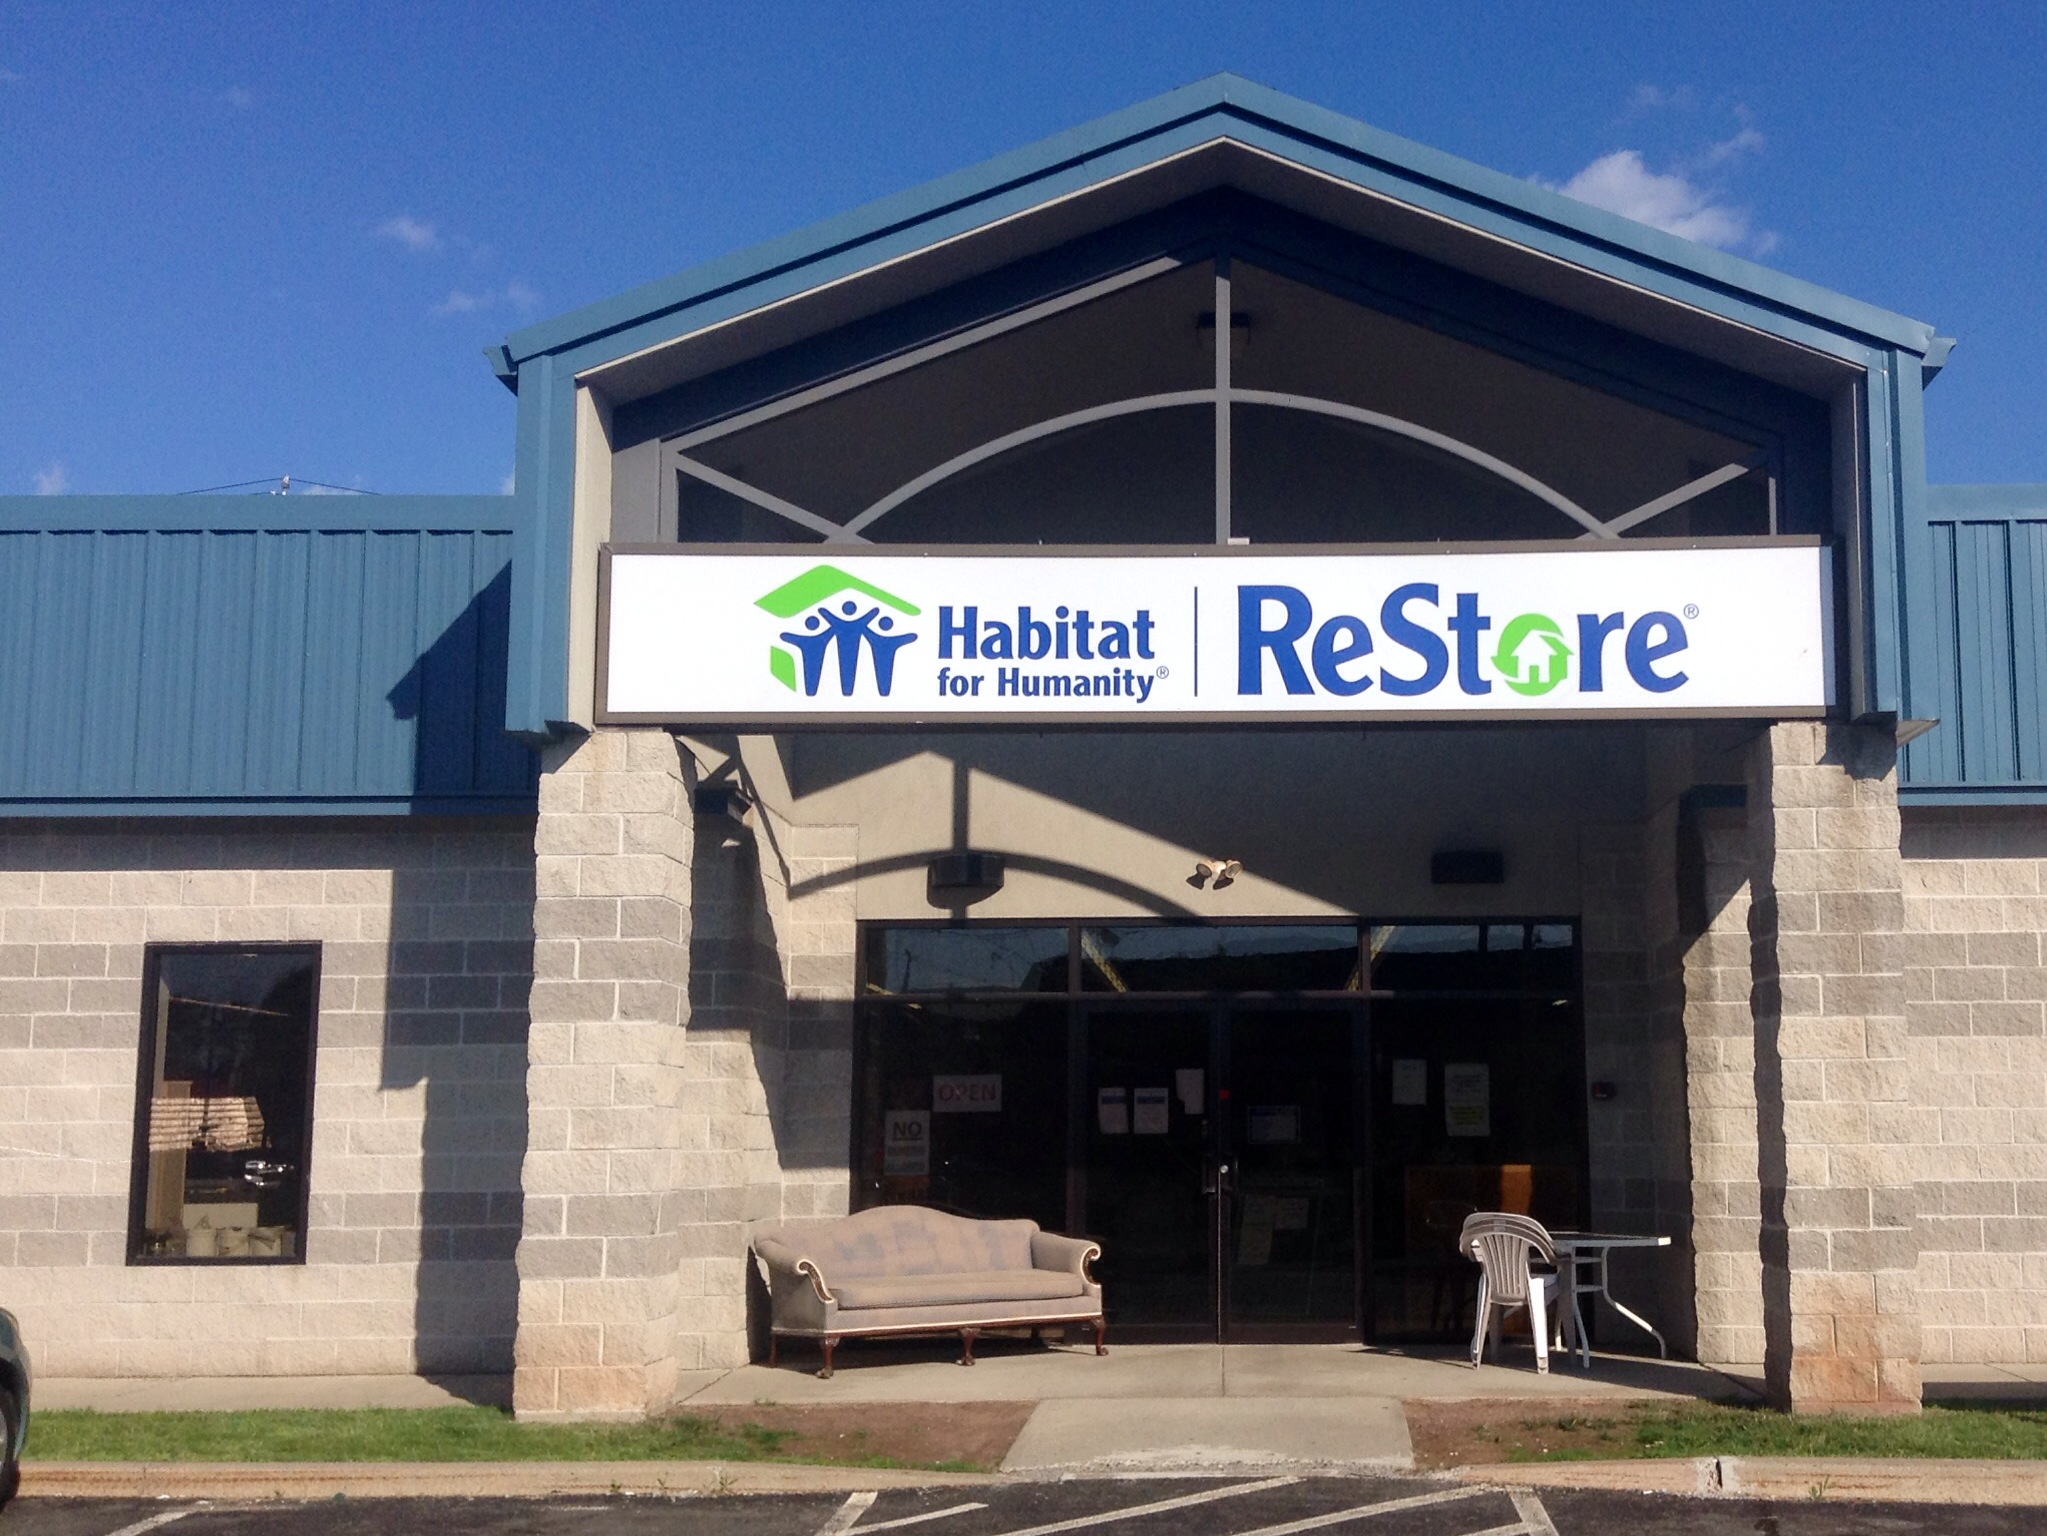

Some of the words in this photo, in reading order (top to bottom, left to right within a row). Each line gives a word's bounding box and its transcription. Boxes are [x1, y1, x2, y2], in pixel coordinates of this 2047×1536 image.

[938, 605, 1155, 660] Habitat
[937, 667, 984, 697] for
[938, 1083, 997, 1101] OPEN
[893, 1121, 922, 1136] NO
